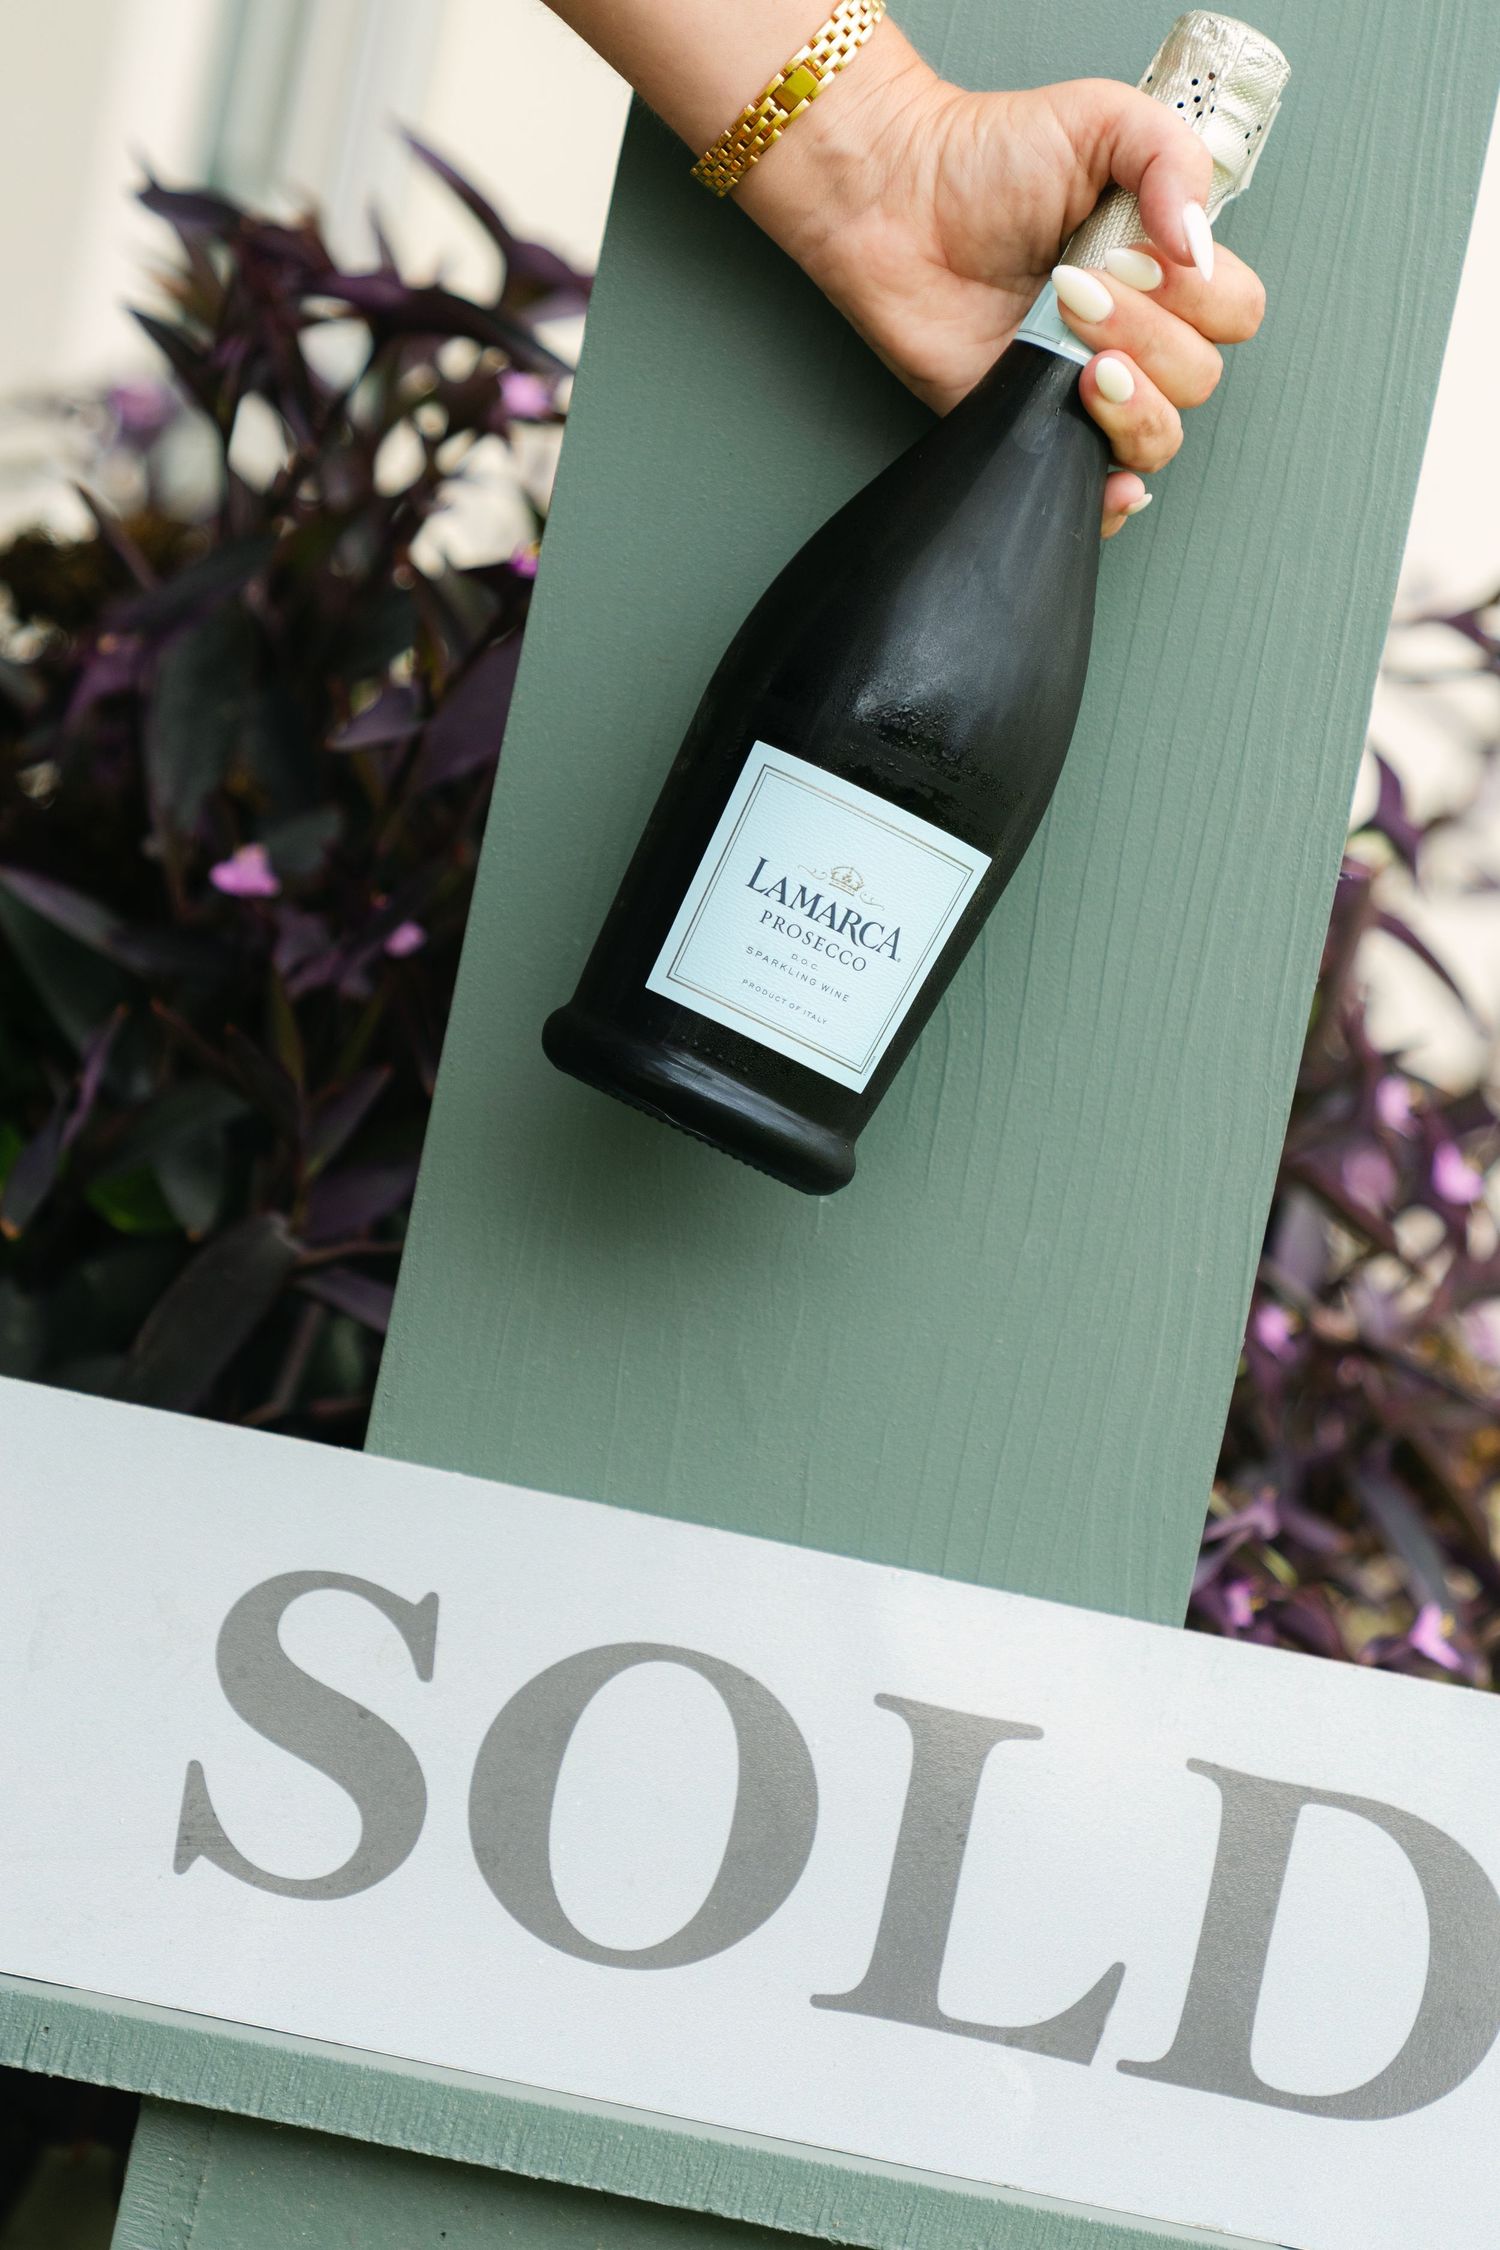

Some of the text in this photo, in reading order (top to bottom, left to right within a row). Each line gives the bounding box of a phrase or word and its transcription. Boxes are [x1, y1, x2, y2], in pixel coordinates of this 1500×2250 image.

[759, 909, 867, 972] PROSECCO
[741, 979, 828, 1025] PRODUCT OF ITALY
[746, 946, 850, 1002] SPARKLING WINE
[173, 1569, 1500, 2121] SOLD
